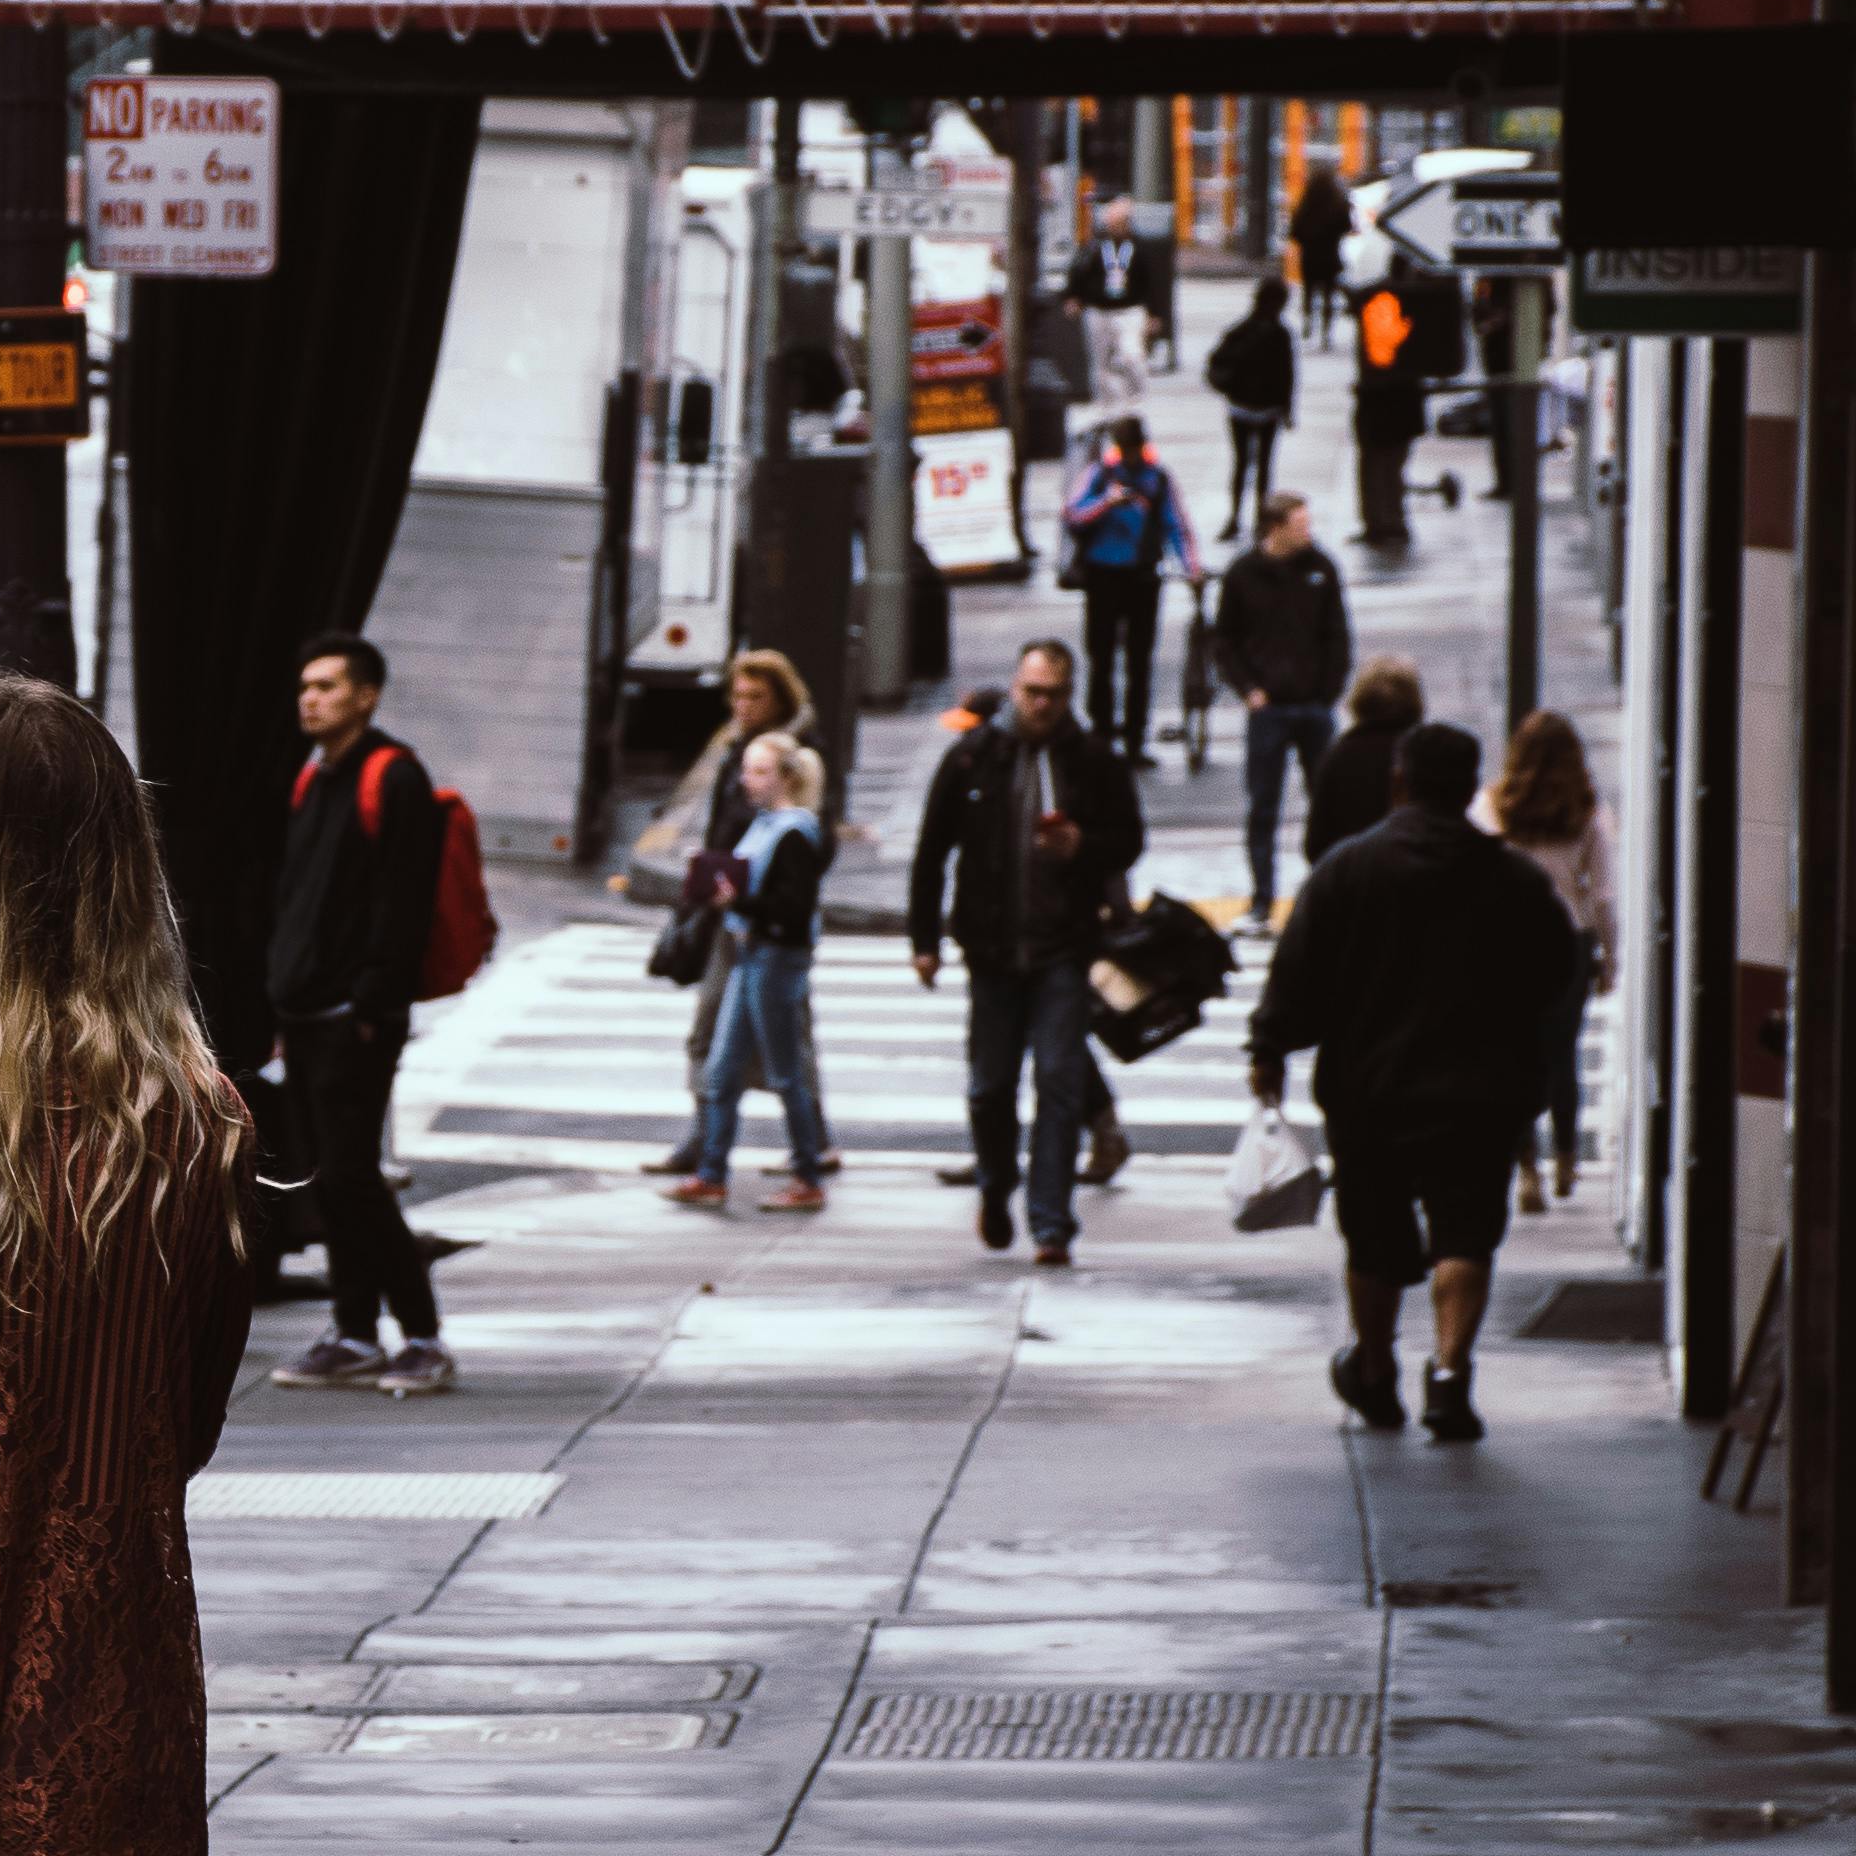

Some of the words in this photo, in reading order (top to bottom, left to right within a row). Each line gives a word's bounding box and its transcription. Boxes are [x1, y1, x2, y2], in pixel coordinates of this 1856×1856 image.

[89, 84, 138, 132] NO
[150, 97, 265, 134] PARKING
[1453, 202, 1527, 240] ONE
[1597, 248, 1782, 281] INSIDE
